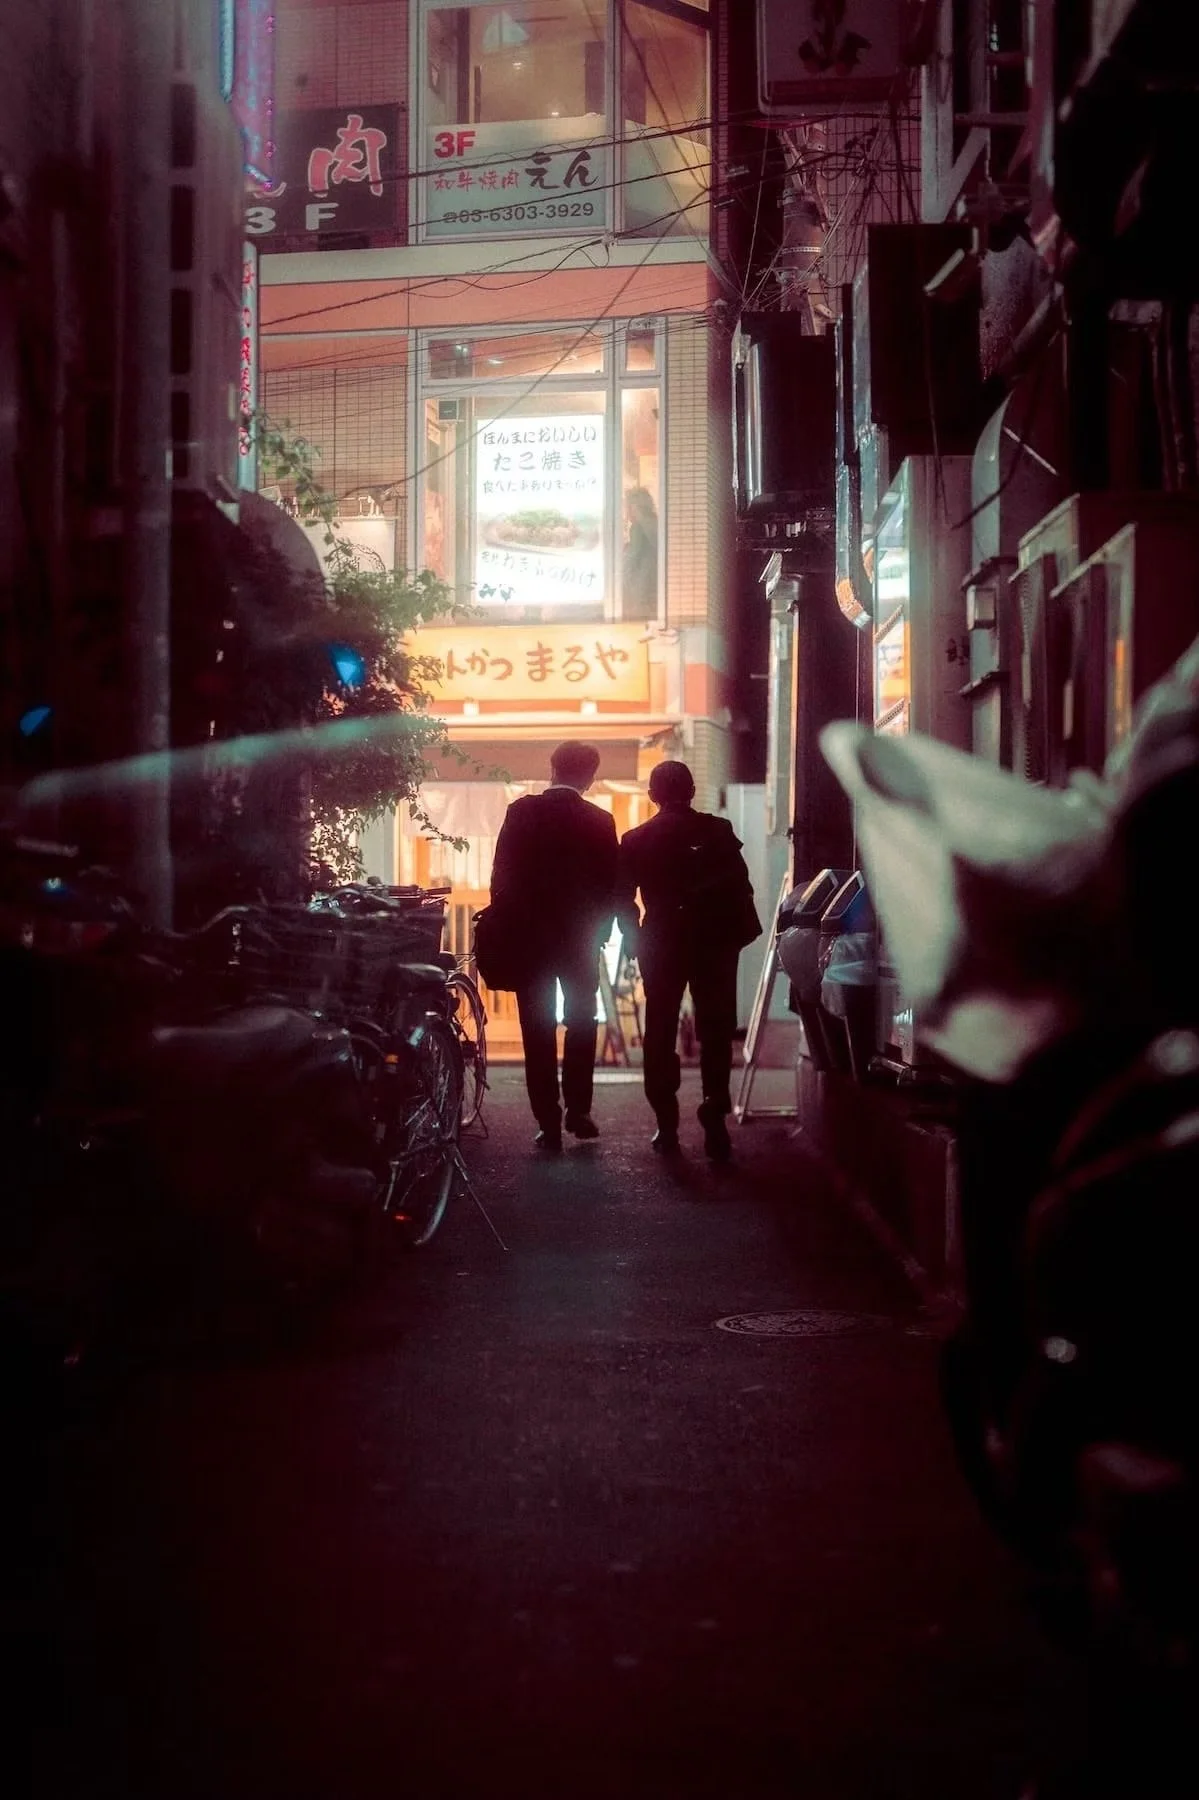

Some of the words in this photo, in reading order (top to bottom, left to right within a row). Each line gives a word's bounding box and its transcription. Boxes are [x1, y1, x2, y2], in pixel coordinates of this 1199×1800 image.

[245, 114, 388, 198] 肉
[434, 130, 476, 158] 3F
[434, 168, 520, 191] 和牛焼肉
[525, 150, 598, 189] えん
[483, 425, 597, 446] ほんまにおいしい
[493, 449, 588, 472] たこ焼き
